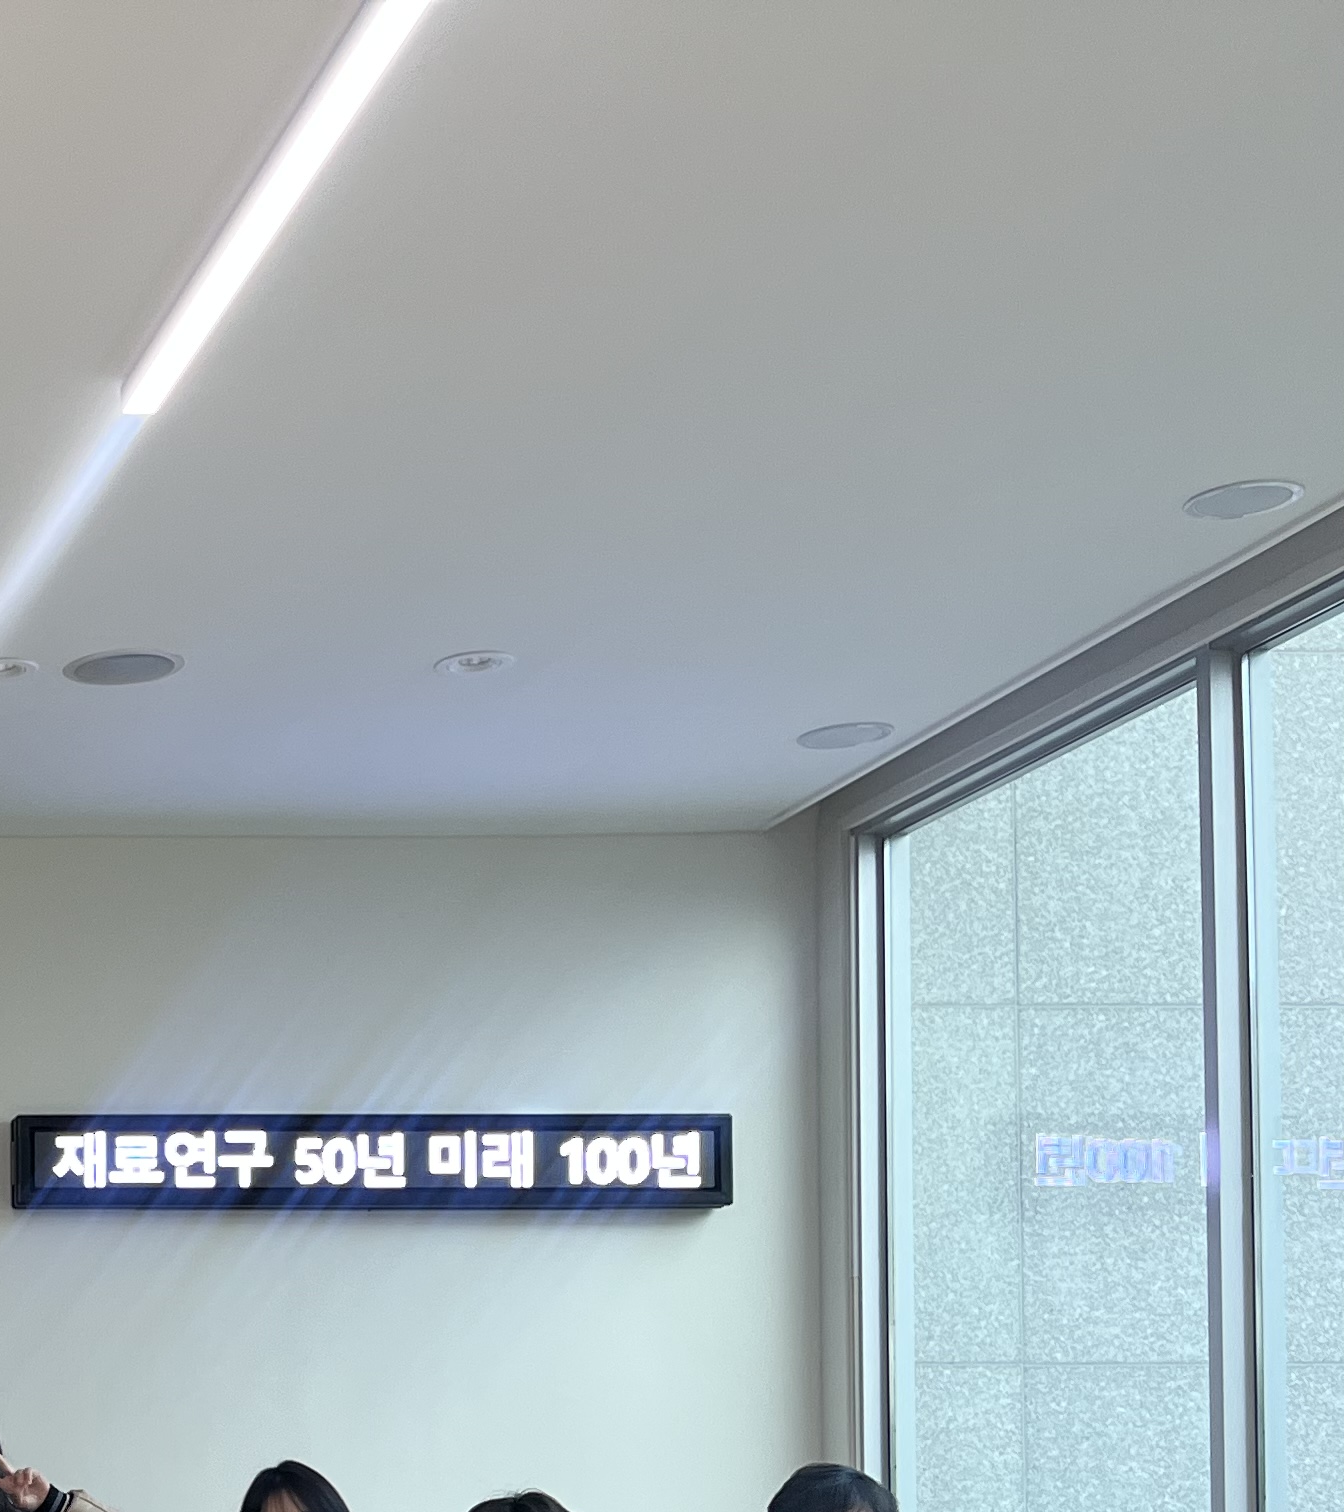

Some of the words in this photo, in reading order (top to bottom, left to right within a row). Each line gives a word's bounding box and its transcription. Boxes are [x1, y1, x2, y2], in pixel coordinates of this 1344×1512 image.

[52, 1130, 275, 1190] 재료연구
[294, 1132, 407, 1189] 50년
[428, 1130, 535, 1189] 미래
[559, 1131, 702, 1189] 100년
